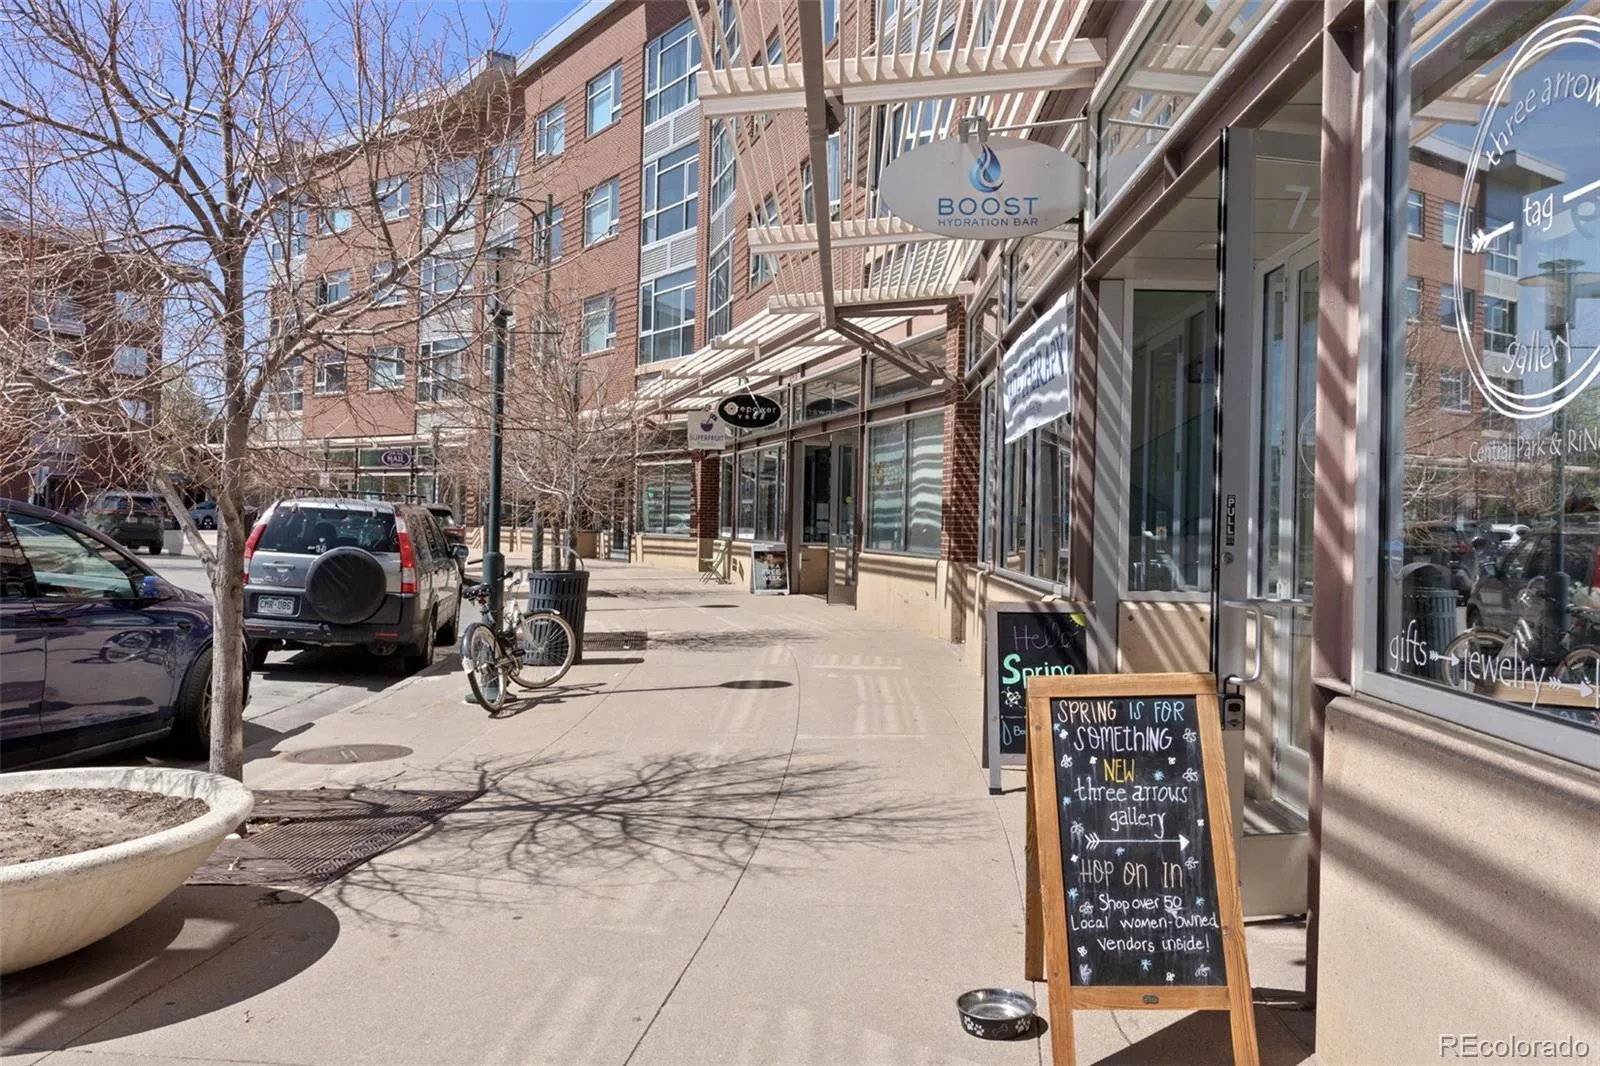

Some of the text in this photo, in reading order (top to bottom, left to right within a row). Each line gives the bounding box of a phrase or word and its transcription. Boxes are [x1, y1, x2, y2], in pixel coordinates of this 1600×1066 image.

[1486, 88, 1537, 166] three
[937, 197, 1039, 216] BOOST
[1522, 193, 1553, 232] tag
[938, 217, 1039, 227] HYDRATION BAR
[1502, 322, 1572, 375] gallery
[1468, 432, 1512, 464] Central
[1517, 431, 1546, 460] Park
[1227, 498, 1235, 535] PULL
[1013, 622, 1080, 650] Hello
[1389, 619, 1427, 672] gifts
[1463, 637, 1546, 710] jewelry
[1057, 699, 1185, 724] SPRING IS FOR
[1103, 758, 1135, 783] NEW
[1073, 776, 1188, 803] three arrows
[1109, 807, 1166, 839] gallery
[1080, 859, 1114, 890] HOP
[1098, 893, 1183, 916] Shop over 50
[1070, 914, 1109, 931] Local
[1161, 933, 1210, 953] inside!
